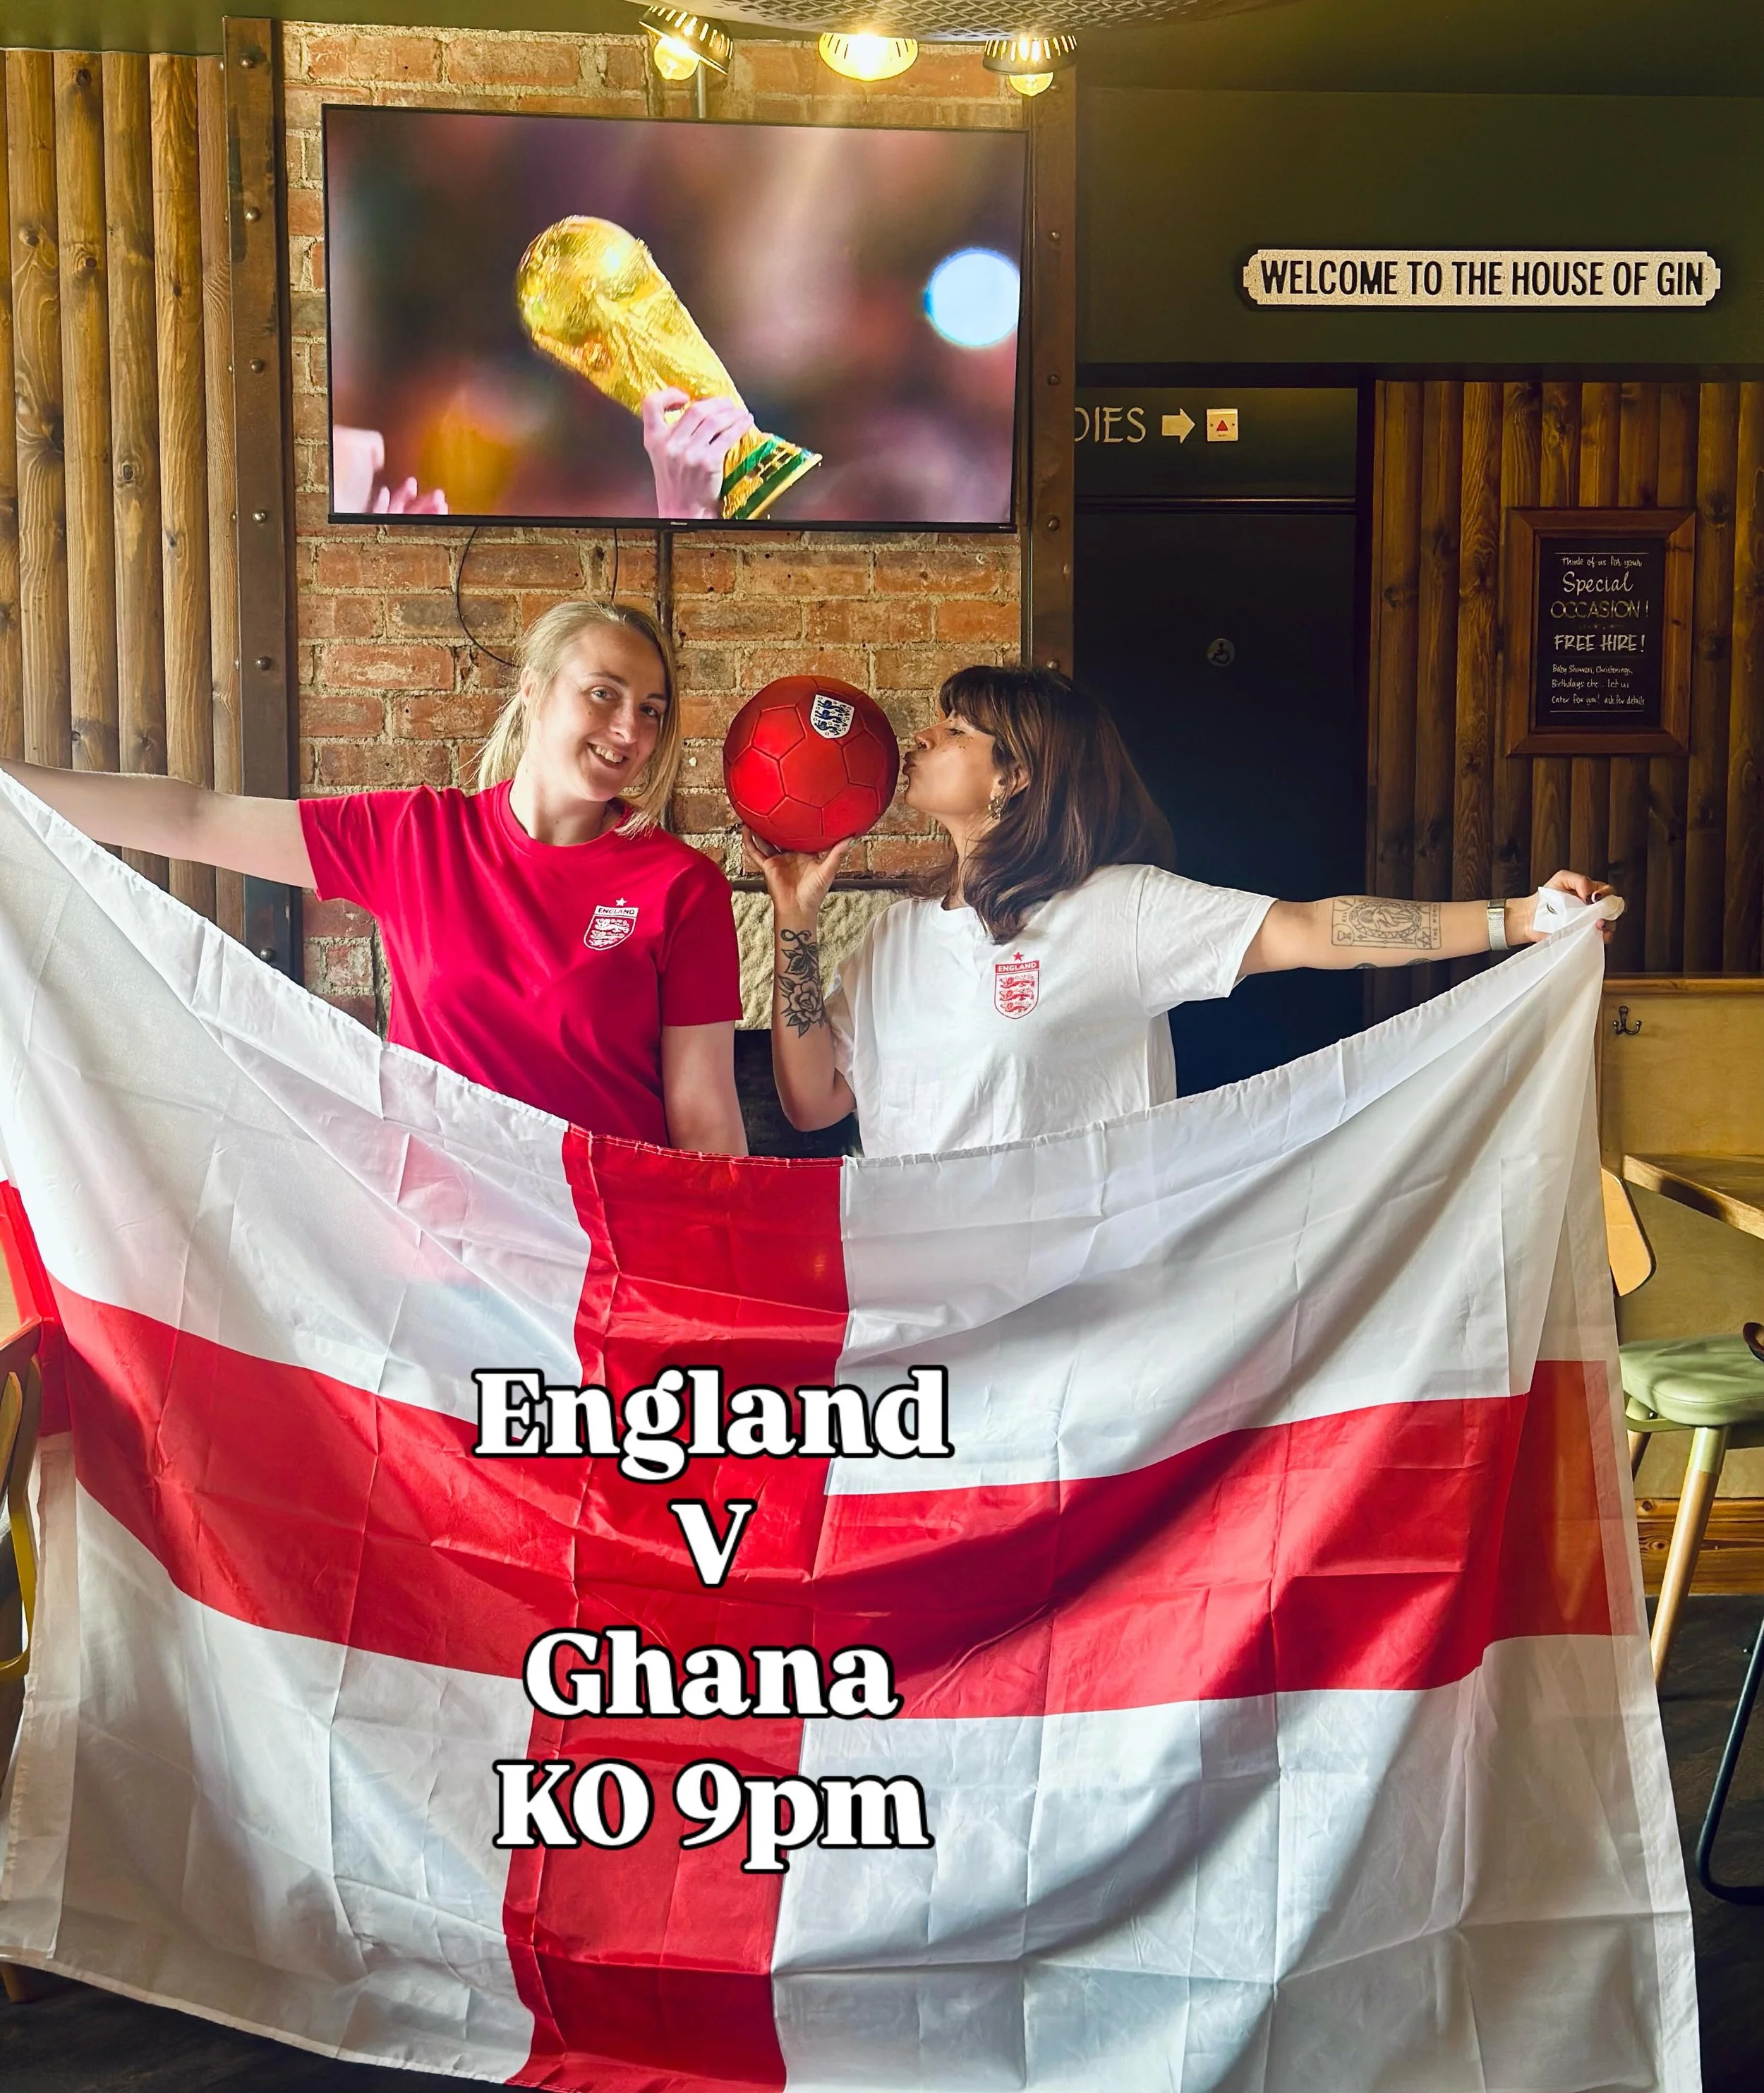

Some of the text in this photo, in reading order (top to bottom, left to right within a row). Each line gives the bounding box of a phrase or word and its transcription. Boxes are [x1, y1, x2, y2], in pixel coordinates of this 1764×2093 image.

[1261, 260, 1703, 296] WELCOME TO THE HOUSE OF GIN
[1587, 555, 1595, 568] of
[1610, 555, 1621, 566] for
[1624, 558, 1643, 569] your
[1562, 571, 1633, 596] Special
[1554, 634, 1595, 651] FREE
[1552, 663, 1567, 675] Baby
[1552, 678, 1584, 689] Birthdays
[1573, 693, 1583, 704] for
[1604, 695, 1614, 704] ask
[1616, 694, 1624, 704] for
[1626, 694, 1645, 706] details
[998, 961, 1037, 972] ENGLAND
